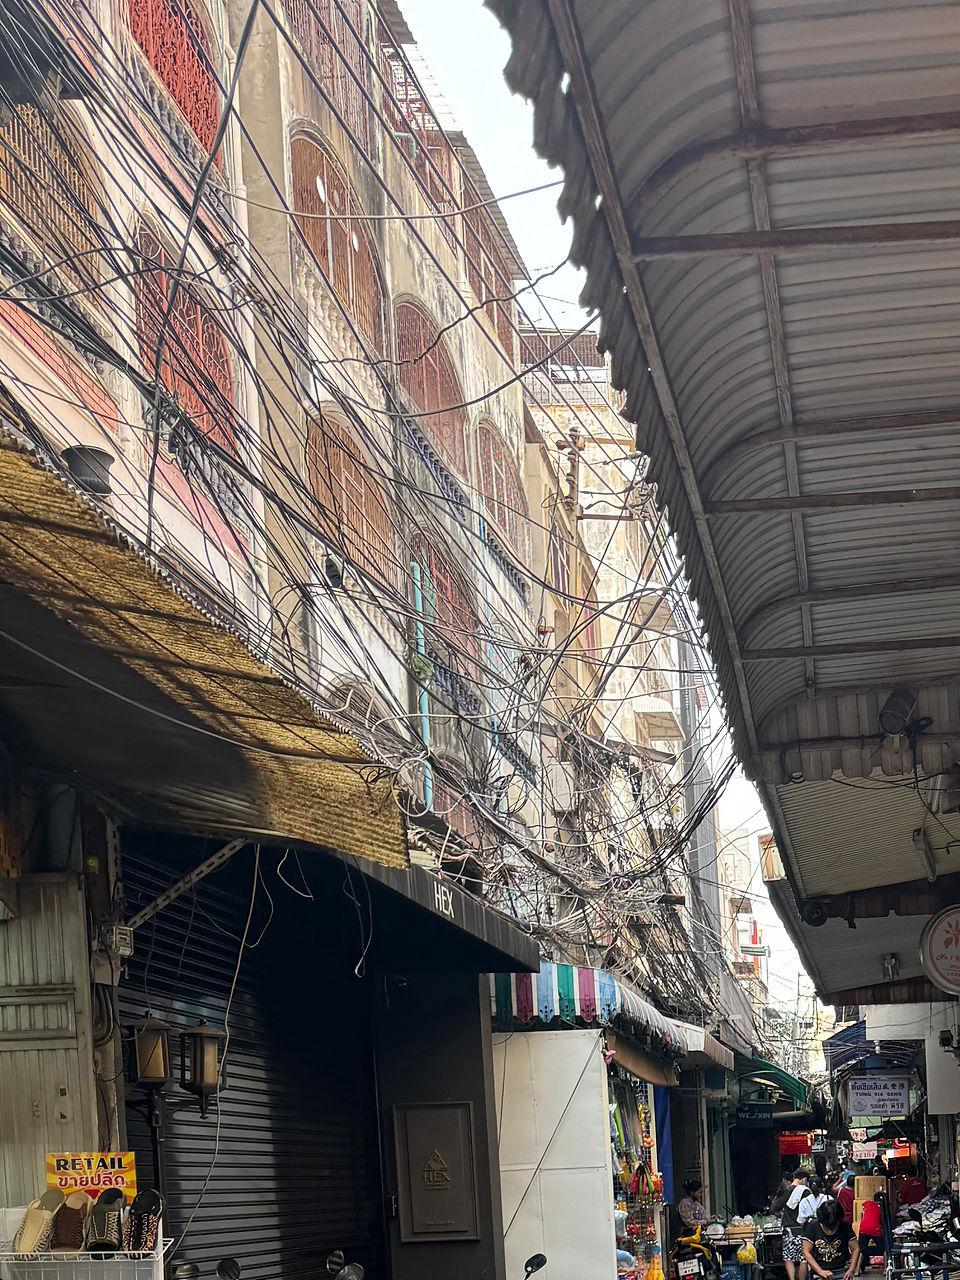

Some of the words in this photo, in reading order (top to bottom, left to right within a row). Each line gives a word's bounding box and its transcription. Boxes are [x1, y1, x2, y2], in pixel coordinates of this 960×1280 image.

[433, 880, 455, 919] HEX
[55, 1157, 128, 1171] RETAIL
[58, 1171, 125, 1187] ขายปลีก
